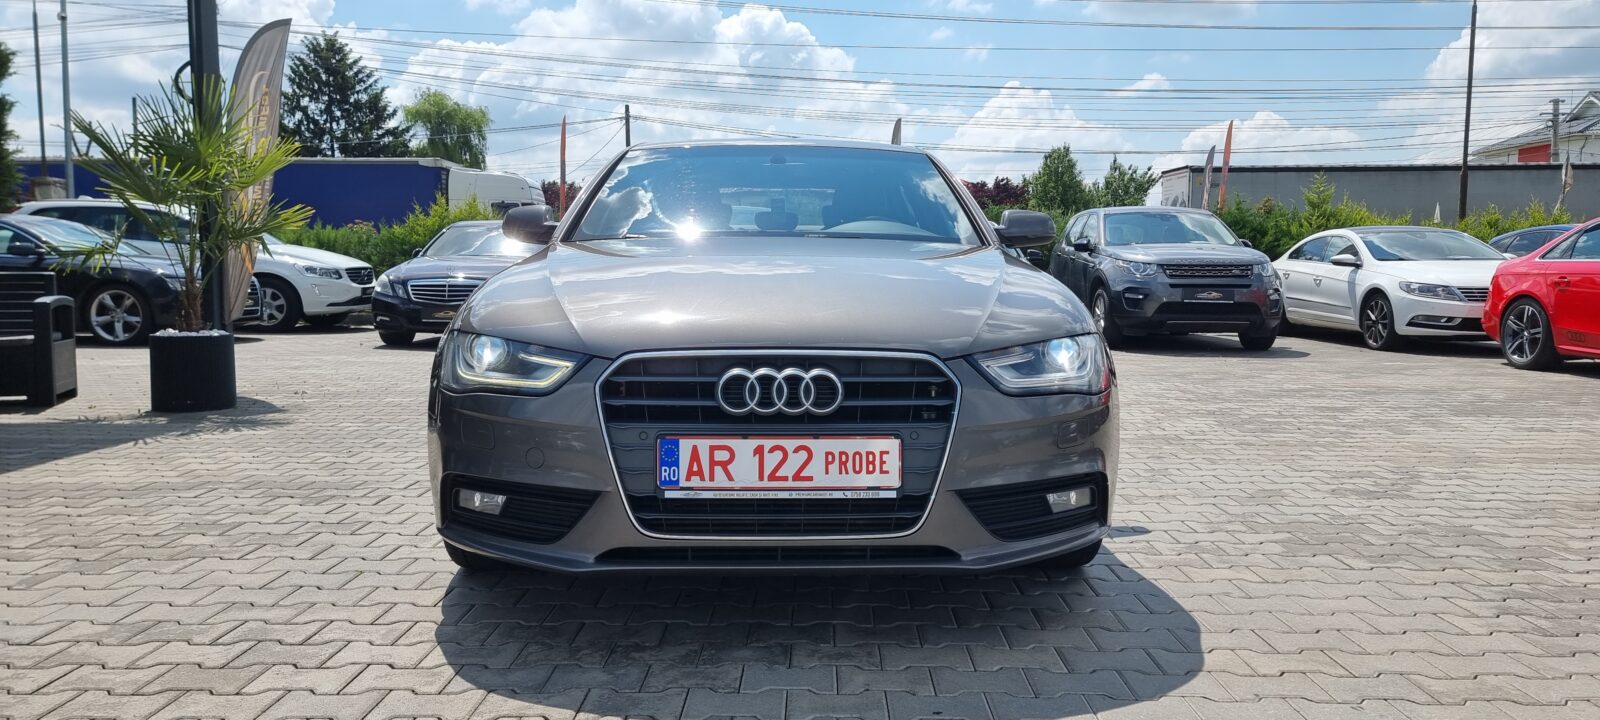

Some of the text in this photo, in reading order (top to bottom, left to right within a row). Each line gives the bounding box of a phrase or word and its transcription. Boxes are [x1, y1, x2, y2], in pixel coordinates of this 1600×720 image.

[661, 466, 678, 481] RO
[685, 445, 889, 481] AR 122 PROBE
